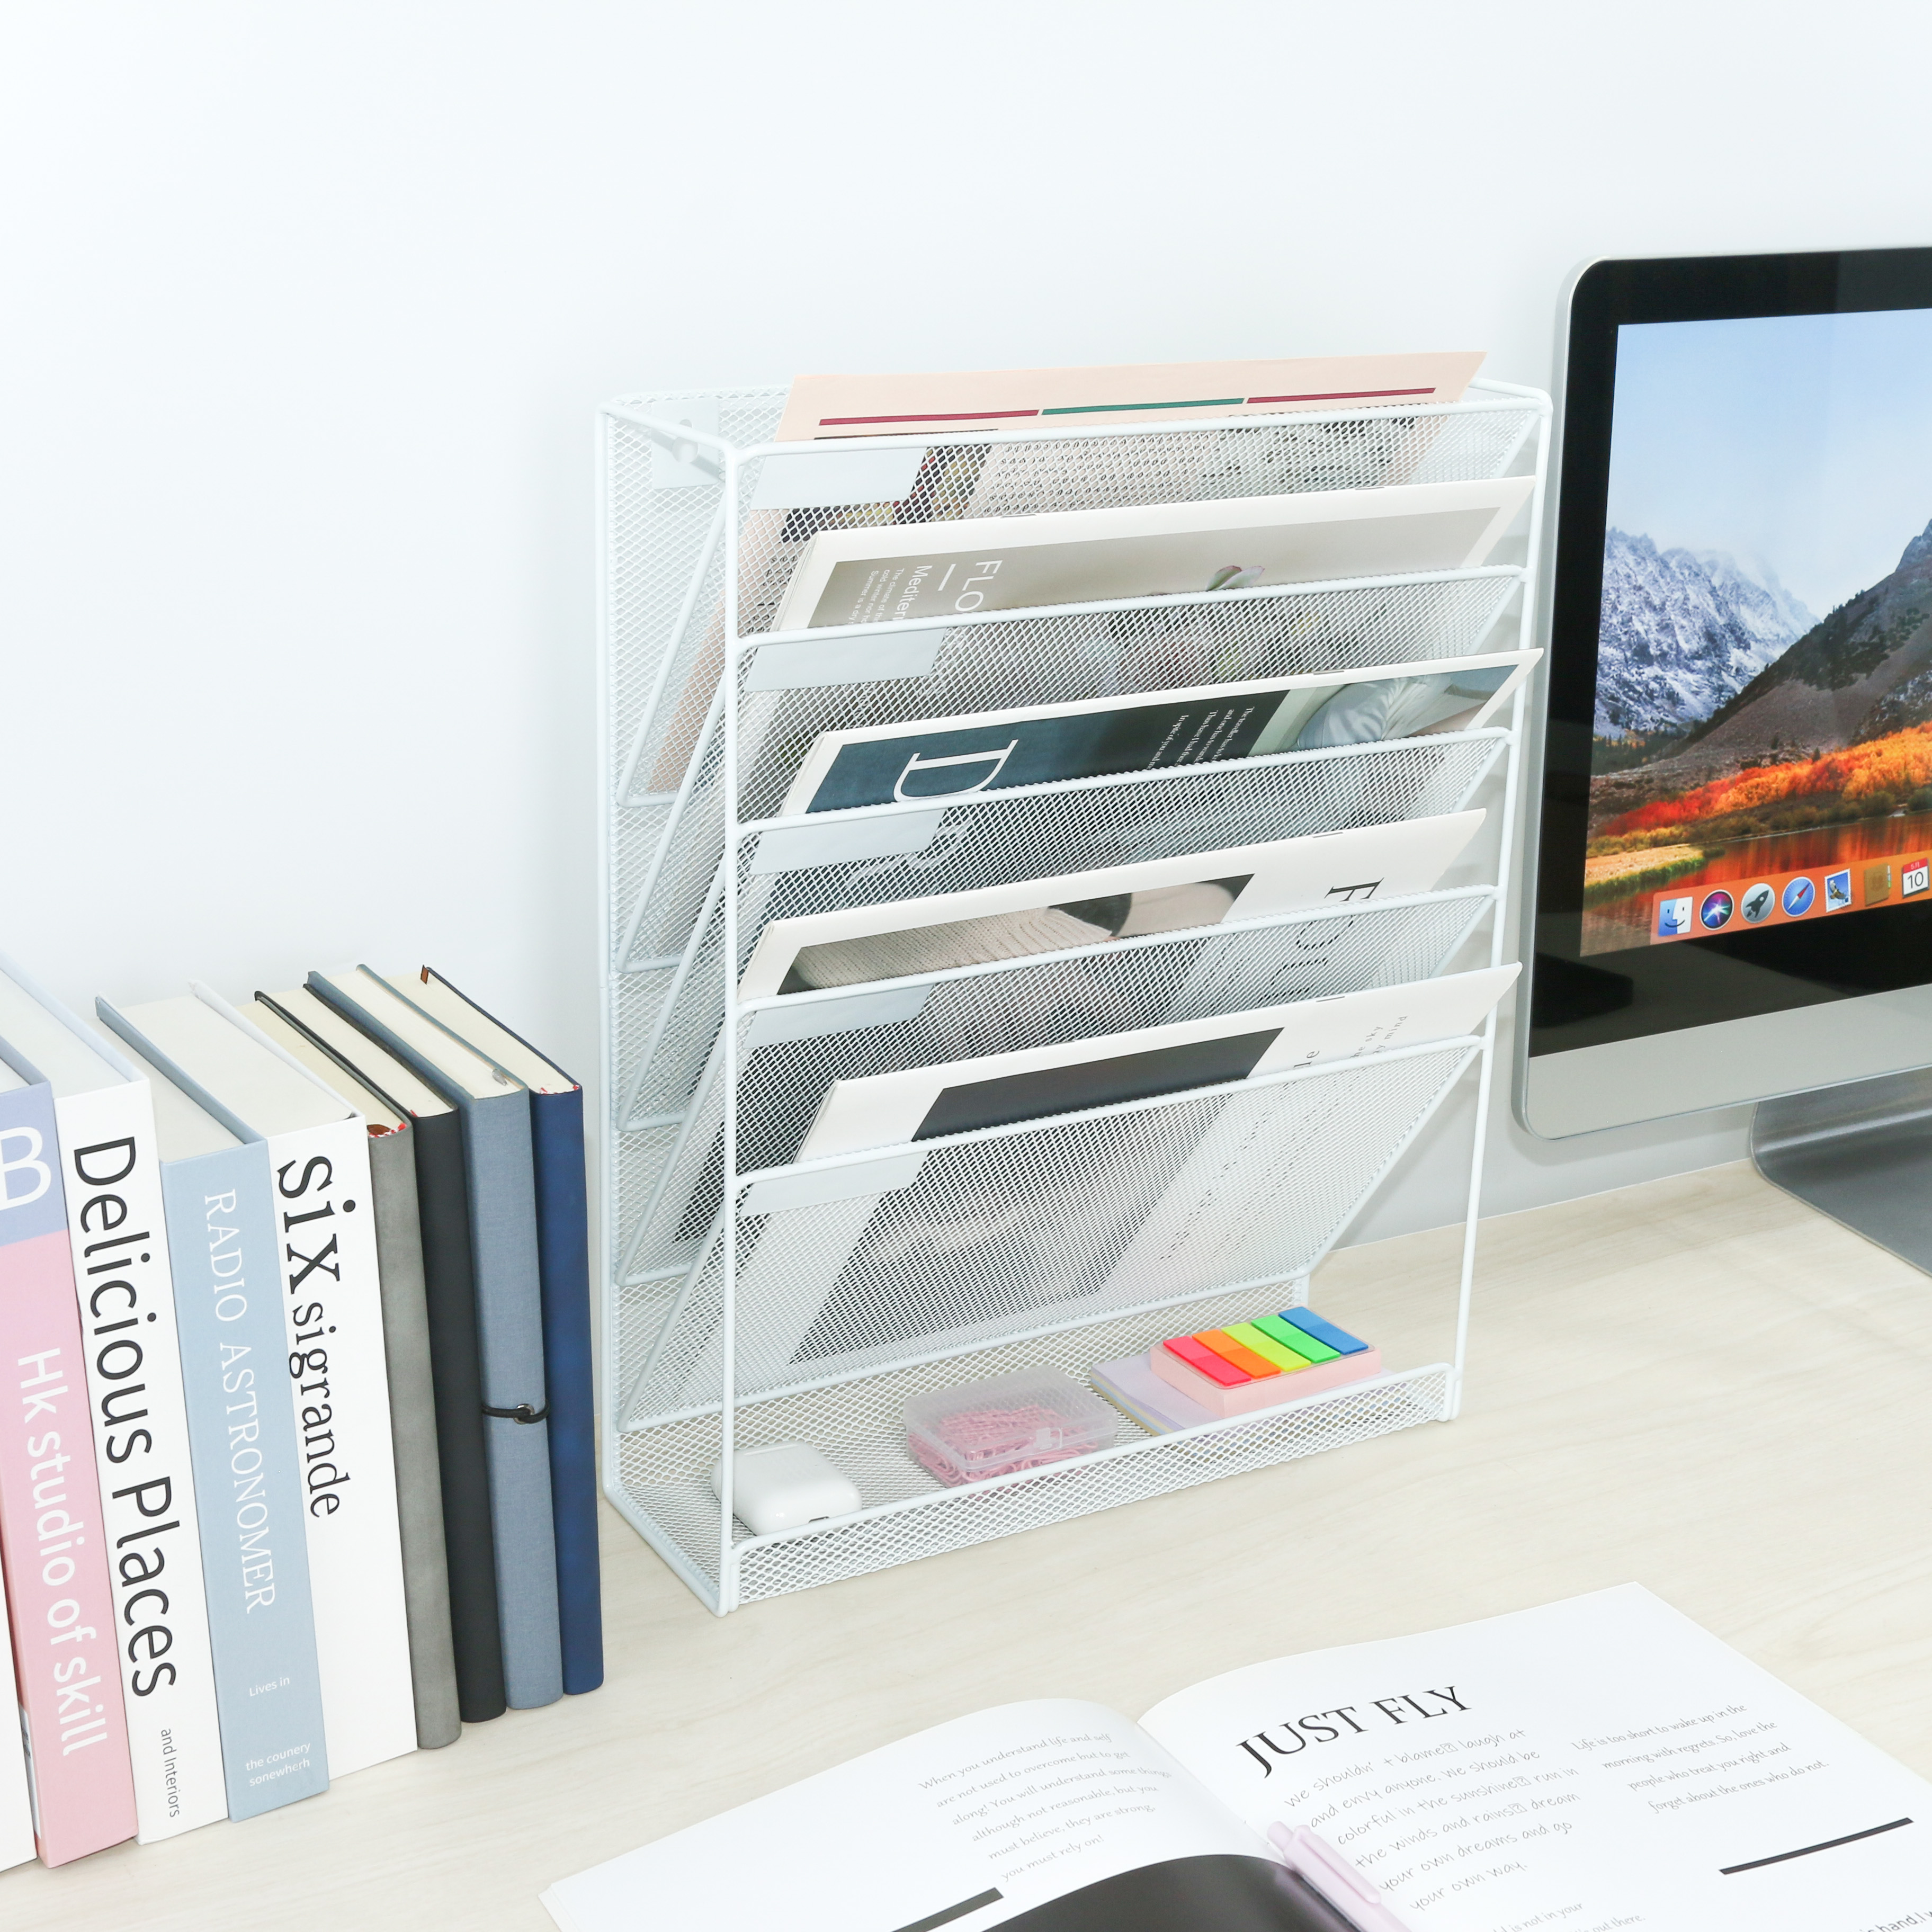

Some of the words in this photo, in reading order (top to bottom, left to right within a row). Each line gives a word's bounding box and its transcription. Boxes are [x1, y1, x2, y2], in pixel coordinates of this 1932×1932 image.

[861, 570, 879, 596] Summer
[879, 569, 890, 582] cold
[892, 568, 905, 580] The
[954, 560, 1003, 612] FLO
[1907, 871, 1924, 889] 10
[1365, 1026, 1383, 1042] sky
[1384, 1016, 1408, 1040] mind
[204, 1188, 247, 1322] RADIO
[74, 1137, 157, 1463] Delicious
[17, 1347, 68, 1424] Hk
[289, 1302, 351, 1518] sigrande
[220, 1342, 276, 1614] ASTRONOMER
[27, 1431, 85, 1586] studio
[112, 1476, 180, 1697] Places
[47, 1598, 97, 1645] of
[53, 1657, 108, 1757] skill
[249, 1681, 278, 1697] Lives
[279, 1676, 290, 1687] in
[160, 1728, 177, 1755] and
[1236, 1706, 1369, 1778] JUST
[1368, 1686, 1472, 1725] FLY
[1458, 1734, 1506, 1749] laugh
[1509, 1729, 1527, 1739] at
[1570, 1738, 1597, 1751] Life
[1626, 1728, 1658, 1739] short
[1668, 1718, 1699, 1731] wake
[1697, 1714, 1715, 1724] up
[1725, 1704, 1748, 1714] the
[1602, 1753, 1654, 1769] morning
[1651, 1747, 1678, 1759] with
[1731, 1727, 1759, 1739] love
[1756, 1721, 1778, 1732] the
[245, 1758, 264, 1771] the
[266, 1743, 311, 1764] counery
[917, 1771, 956, 1790] When
[958, 1763, 981, 1778] you
[981, 1739, 1048, 1766] understand
[1048, 1736, 1068, 1747] life
[1070, 1733, 1093, 1743] and
[1093, 1733, 1113, 1743] self
[936, 1796, 956, 1808] are
[958, 1785, 979, 1799] not
[979, 1773, 1009, 1790] used
[1024, 1756, 1077, 1774] overcome
[1076, 1752, 1098, 1760] but
[1114, 1751, 1131, 1759] get
[1627, 1774, 1666, 1792] people
[1664, 1770, 1690, 1781] who
[1688, 1763, 1719, 1775] treat
[1716, 1759, 1740, 1772] you
[1739, 1751, 1768, 1764] right
[1767, 1742, 1792, 1756] and
[164, 1757, 181, 1818] Interiors
[989, 1795, 1016, 1808] You
[1016, 1784, 1039, 1799] will
[1039, 1768, 1107, 1791] understand
[1311, 1803, 1339, 1828] and
[1343, 1789, 1383, 1809] envy
[1469, 1754, 1519, 1772] should
[1516, 1750, 1540, 1761] be
[1338, 1810, 1397, 1845] colorful
[1395, 1806, 1416, 1818] in
[1417, 1796, 1448, 1811] the
[1533, 1770, 1562, 1783] run
[1559, 1767, 1579, 1779] in
[1648, 1796, 1687, 1814] forget
[1686, 1788, 1721, 1803] about
[1716, 1784, 1739, 1795] the
[1739, 1778, 1766, 1790] ones
[1764, 1772, 1790, 1783] who
[1788, 1766, 1805, 1776] do
[972, 1815, 1026, 1841] although
[1027, 1806, 1049, 1819] not
[1113, 1785, 1137, 1794] but
[1137, 1785, 1159, 1794] you
[988, 1841, 1021, 1860] must
[1065, 1817, 1092, 1829] they
[1093, 1810, 1113, 1821] are
[1355, 1848, 1387, 1868] the
[1388, 1827, 1438, 1850] winds
[1443, 1815, 1471, 1832] and
[1530, 1793, 1581, 1810] dream
[1001, 1866, 1026, 1883] you
[1026, 1851, 1059, 1869] must
[1059, 1842, 1083, 1856] rely
[1379, 1867, 1414, 1891] your
[1420, 1853, 1455, 1871] own
[1457, 1833, 1518, 1857] dreams
[1522, 1822, 1551, 1839] and
[1553, 1822, 1572, 1835] go
[1409, 1887, 1445, 1911] your
[1451, 1874, 1486, 1891] own
[1523, 1915, 1544, 1928] not
[1557, 1903, 1584, 1919] your
